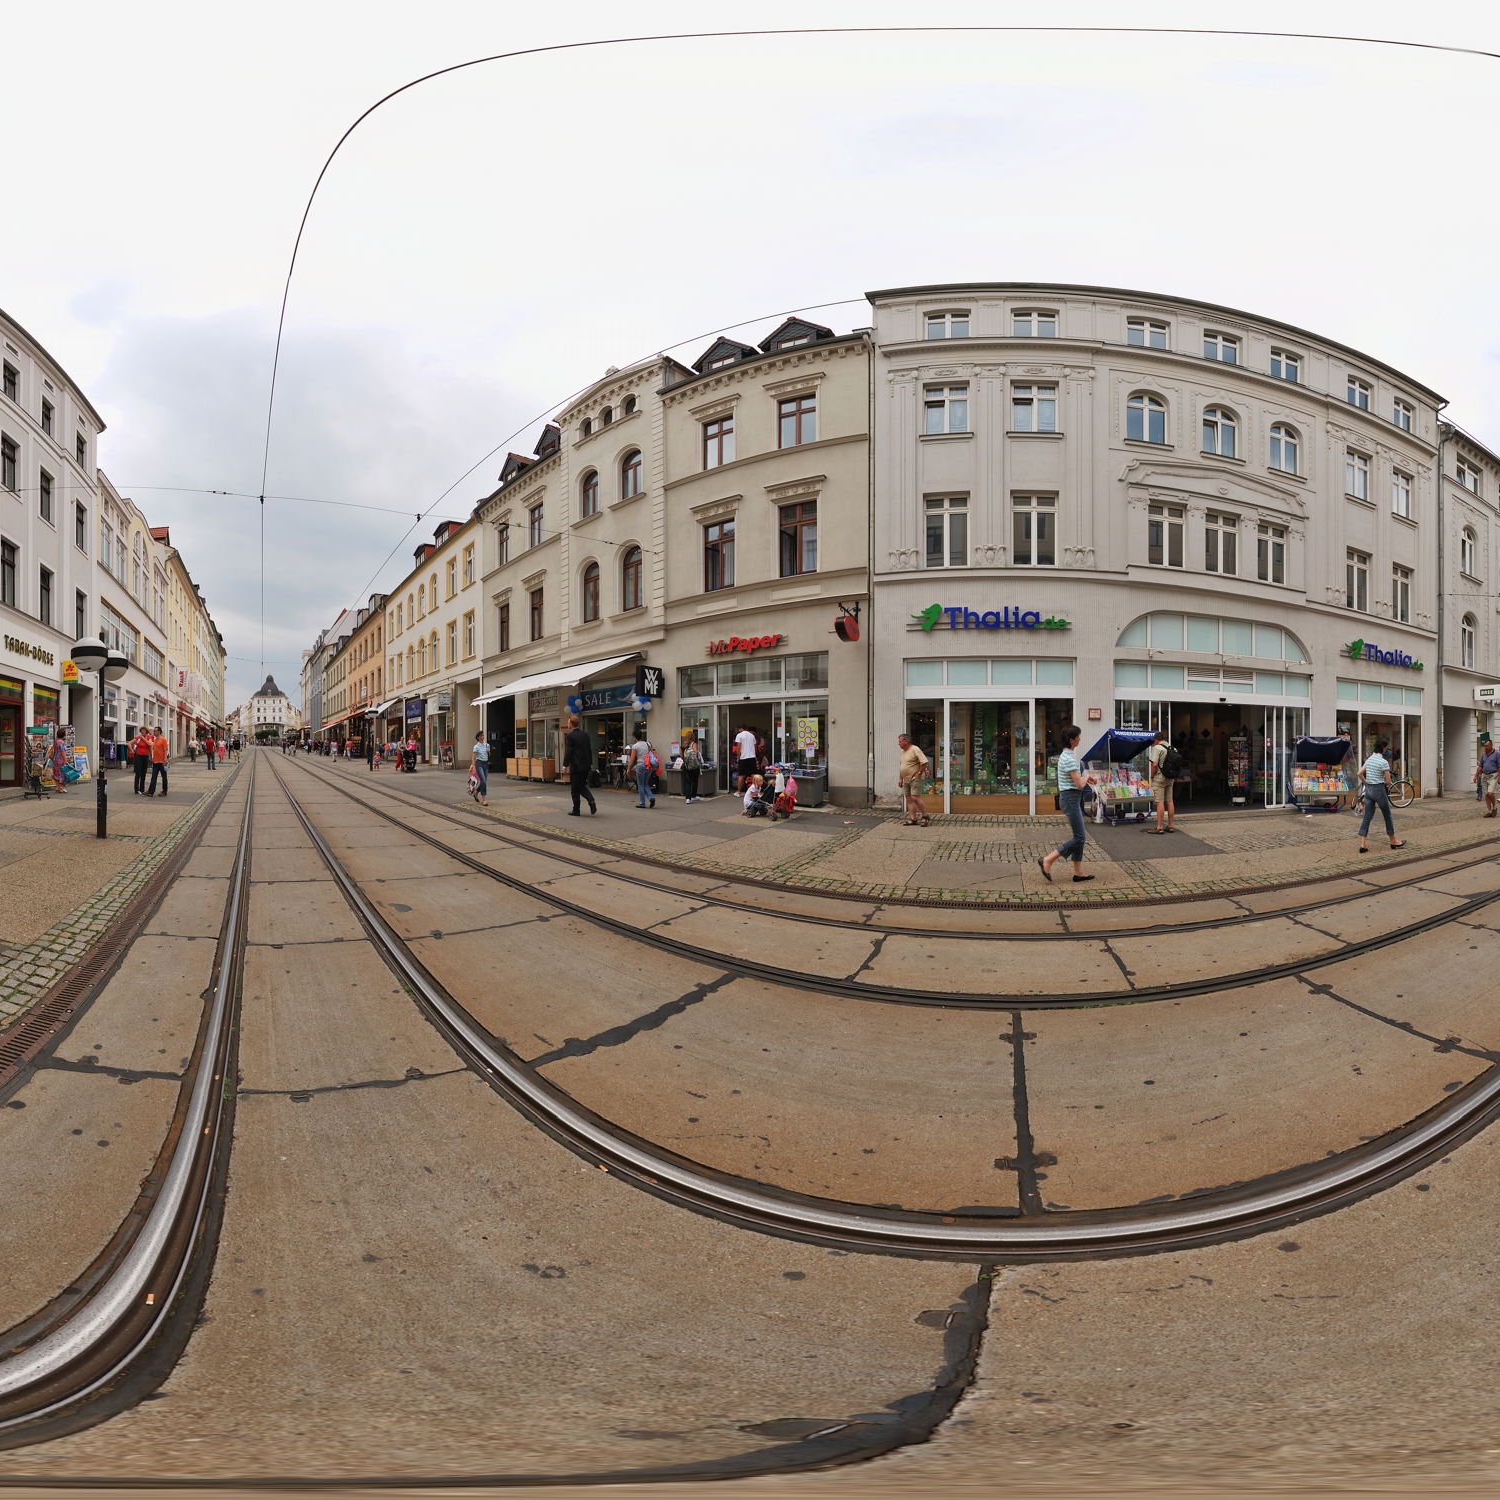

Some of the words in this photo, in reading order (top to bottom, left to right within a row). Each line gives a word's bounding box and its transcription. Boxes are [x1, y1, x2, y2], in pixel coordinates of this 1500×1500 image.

[4, 634, 55, 667] TABAK-BÖRSE
[708, 633, 783, 655] McPaper
[584, 691, 612, 707] SALE
